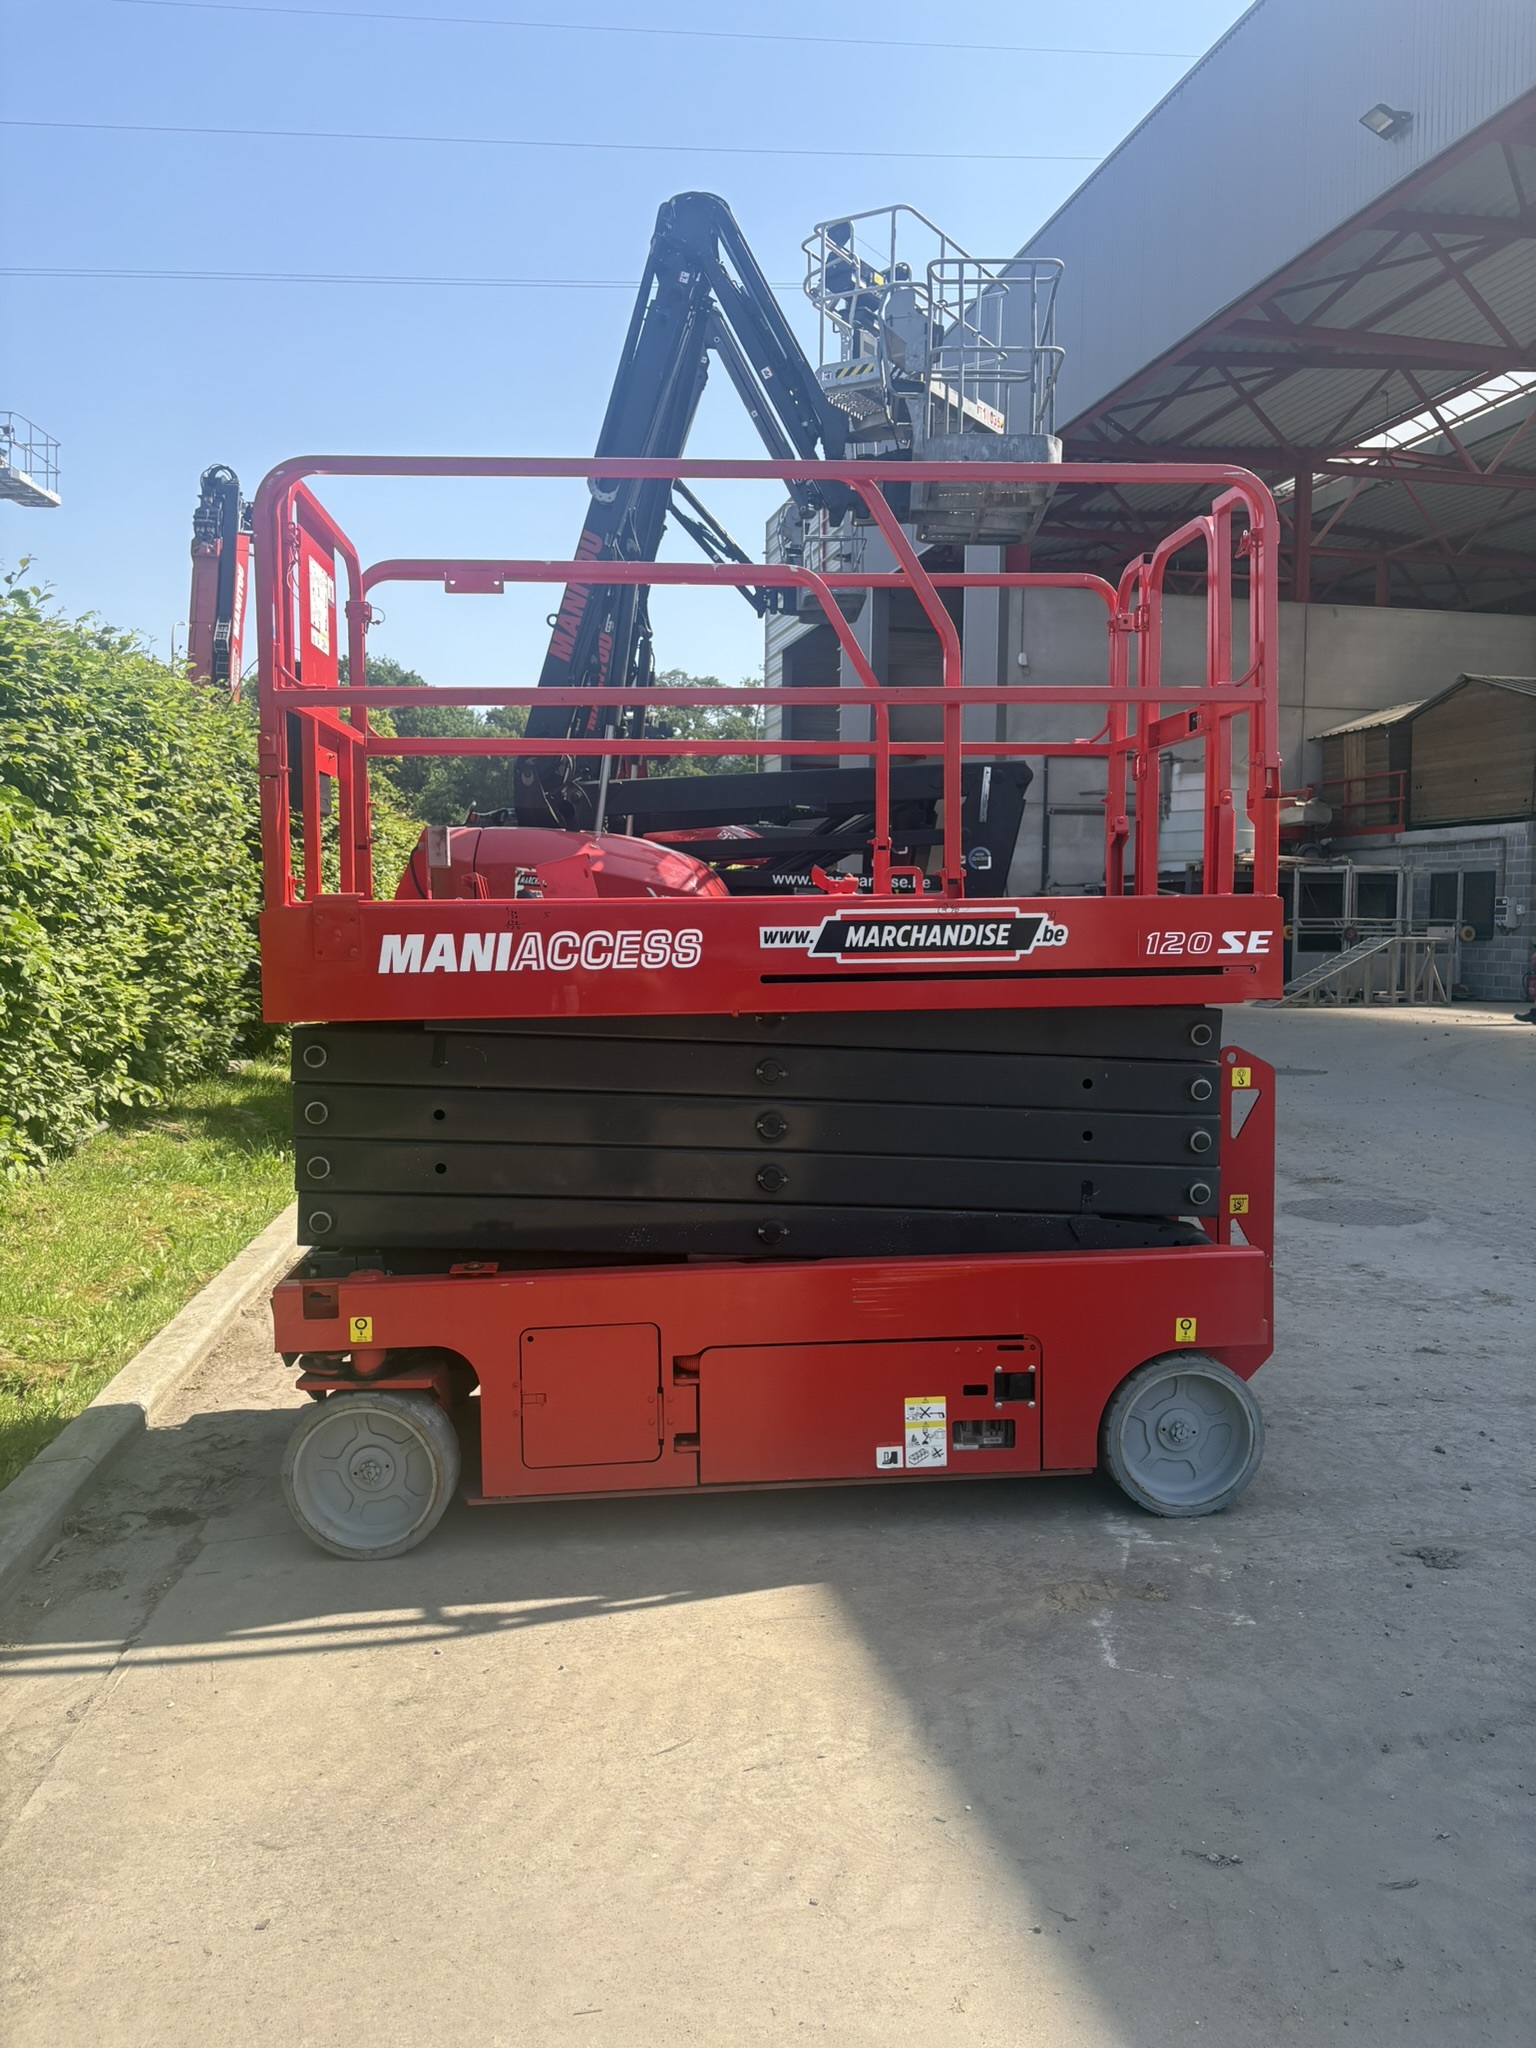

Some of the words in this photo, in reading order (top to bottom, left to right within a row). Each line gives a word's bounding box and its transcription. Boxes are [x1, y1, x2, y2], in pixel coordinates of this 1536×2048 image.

[232, 562, 245, 640] MANITOU
[549, 529, 603, 662] MANIOU
[378, 929, 703, 973] MANIACCESS
[763, 929, 814, 944] www.
[845, 924, 1011, 947] MARCHANDISE
[1036, 924, 1065, 943] .be
[1146, 931, 1213, 955] 120
[1217, 930, 1274, 954] SE
